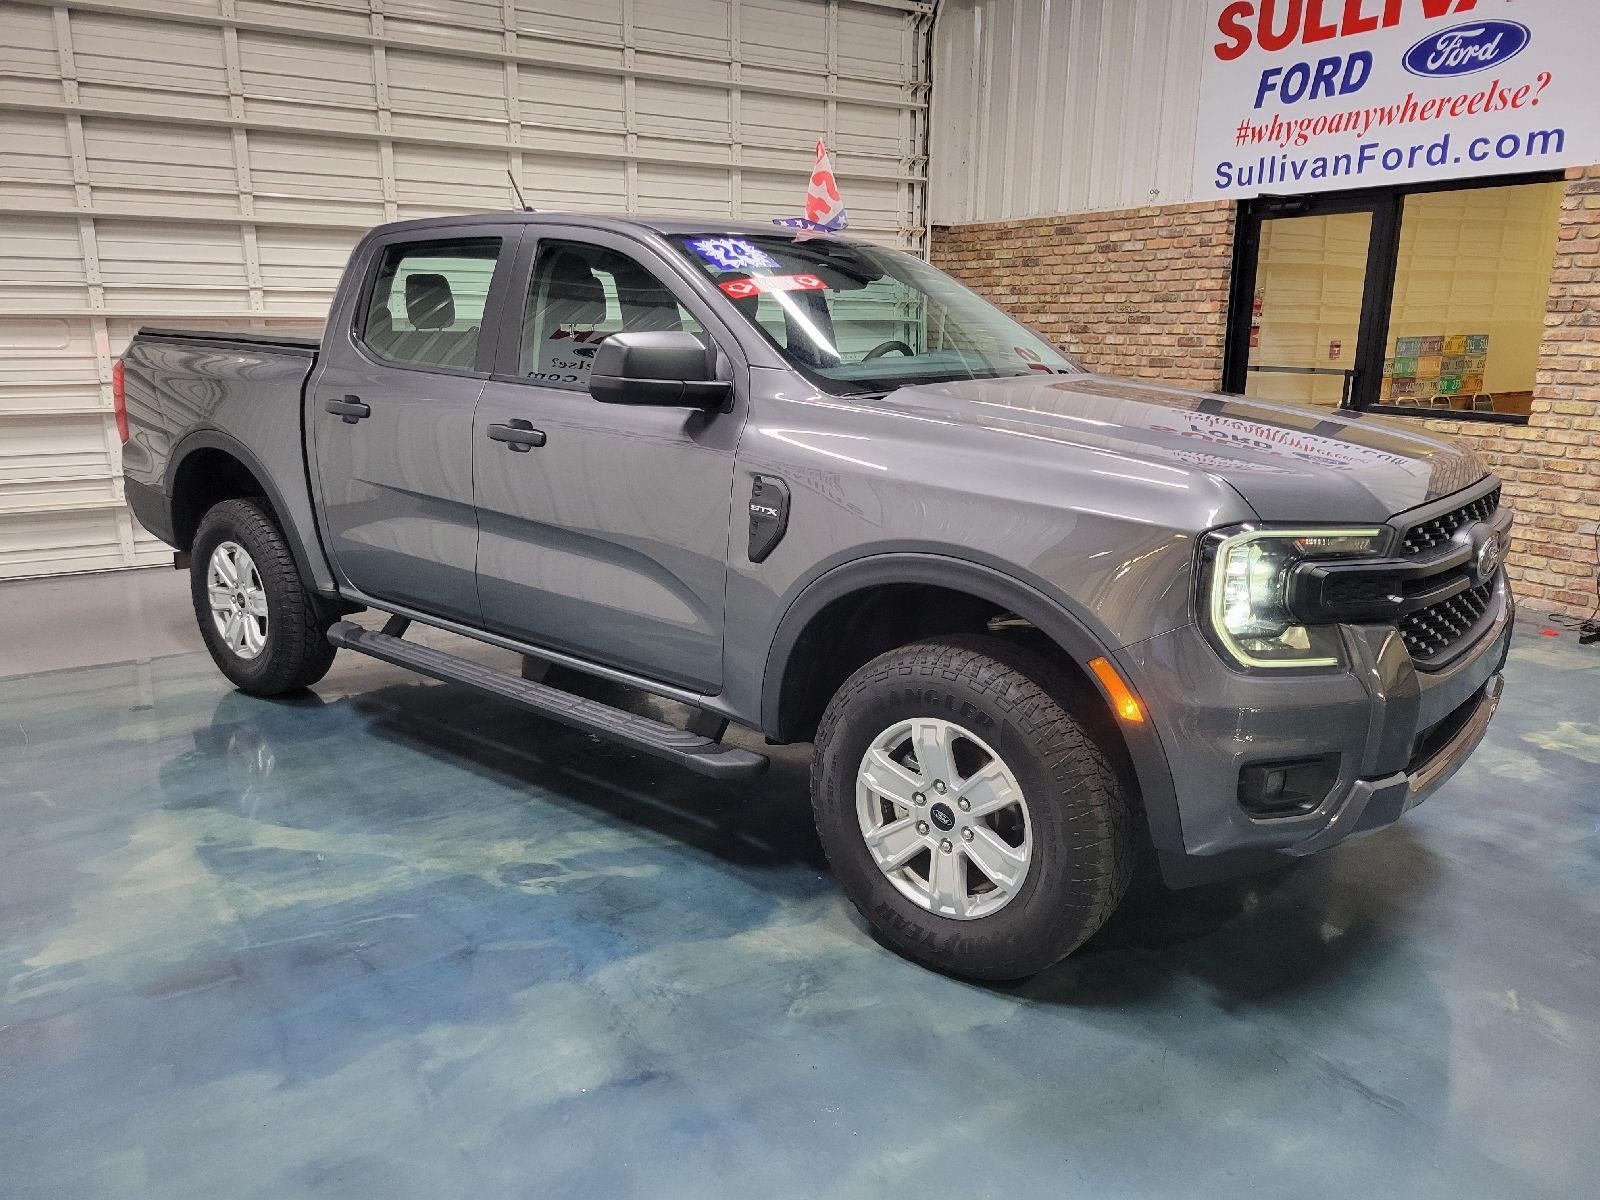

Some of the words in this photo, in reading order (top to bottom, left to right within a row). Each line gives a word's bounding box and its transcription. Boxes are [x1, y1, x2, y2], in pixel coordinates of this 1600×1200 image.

[1254, 50, 1373, 108] FORD
[1427, 28, 1500, 71] Ford
[1236, 72, 1552, 148] #whygoanywhereelse?
[1214, 128, 1566, 189] SullivanFord.com
